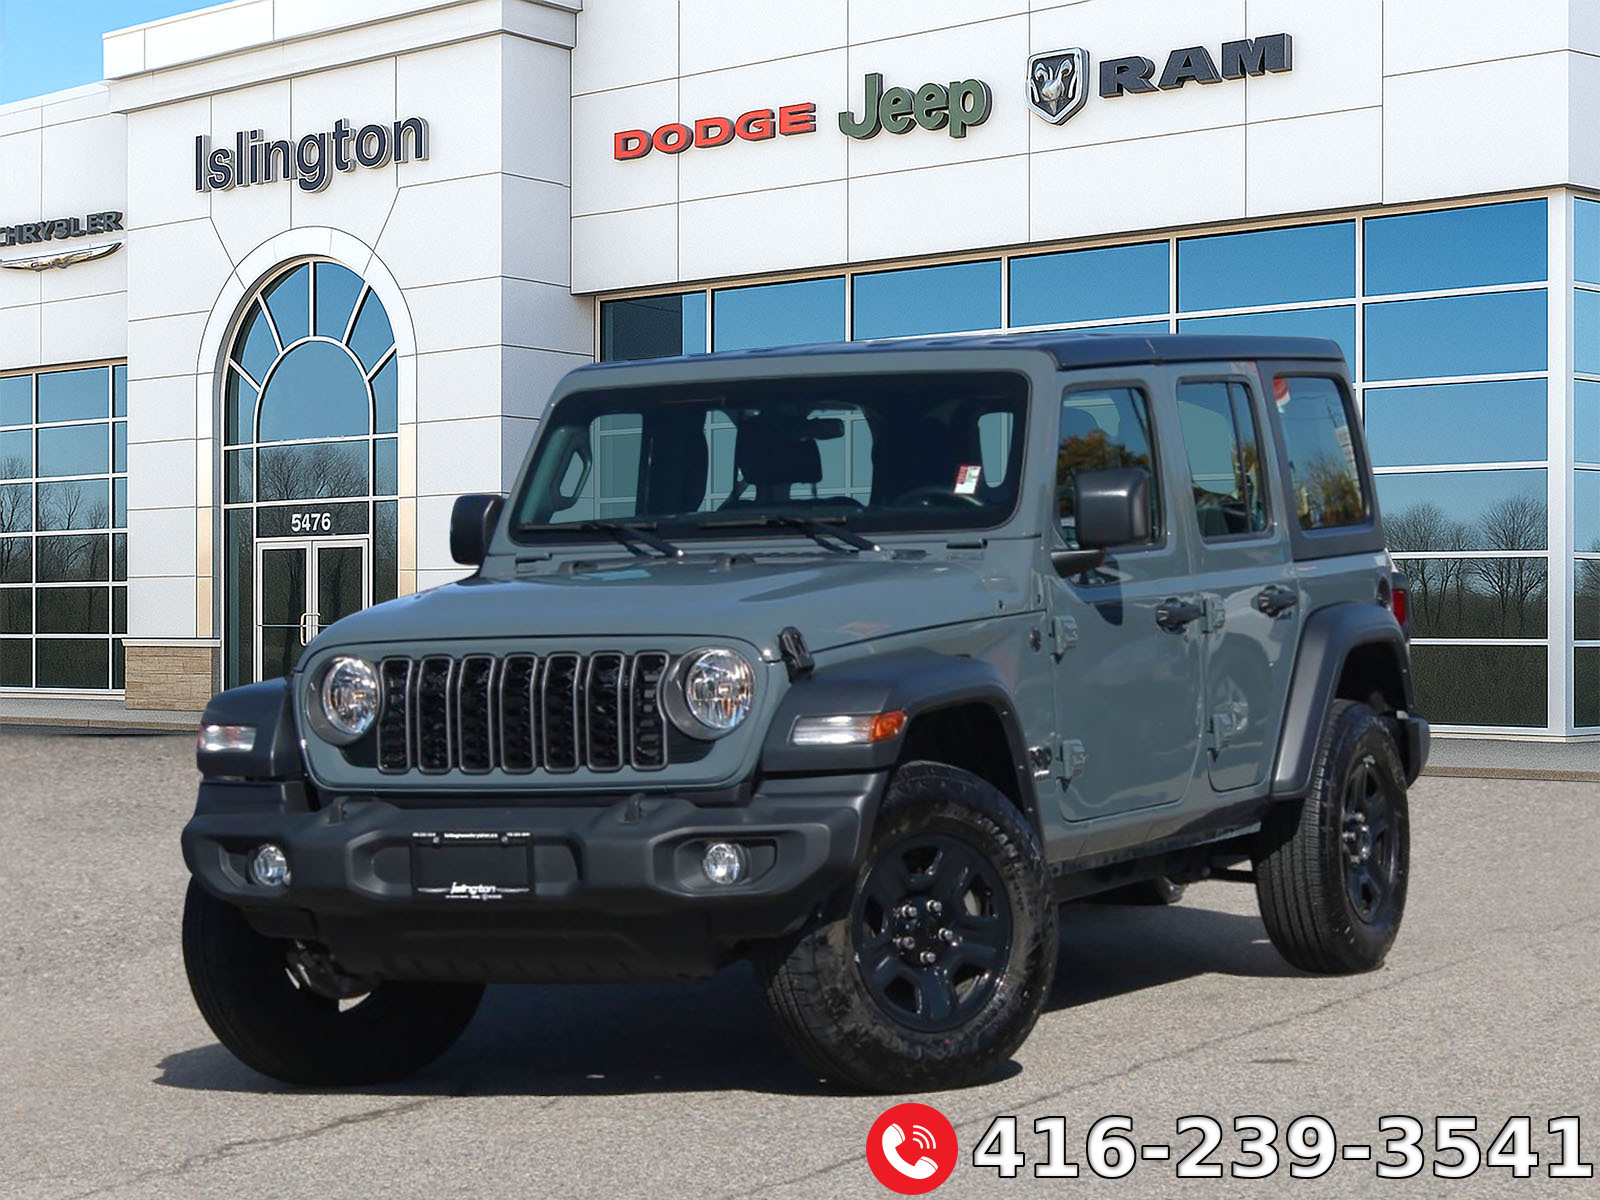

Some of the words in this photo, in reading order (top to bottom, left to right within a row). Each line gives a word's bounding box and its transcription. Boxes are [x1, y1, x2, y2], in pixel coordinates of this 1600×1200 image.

[613, 101, 817, 161] DODGE
[838, 72, 993, 141] Jeep
[1099, 32, 1293, 98] RAM
[195, 115, 430, 192] Islington
[291, 512, 332, 532] 5476
